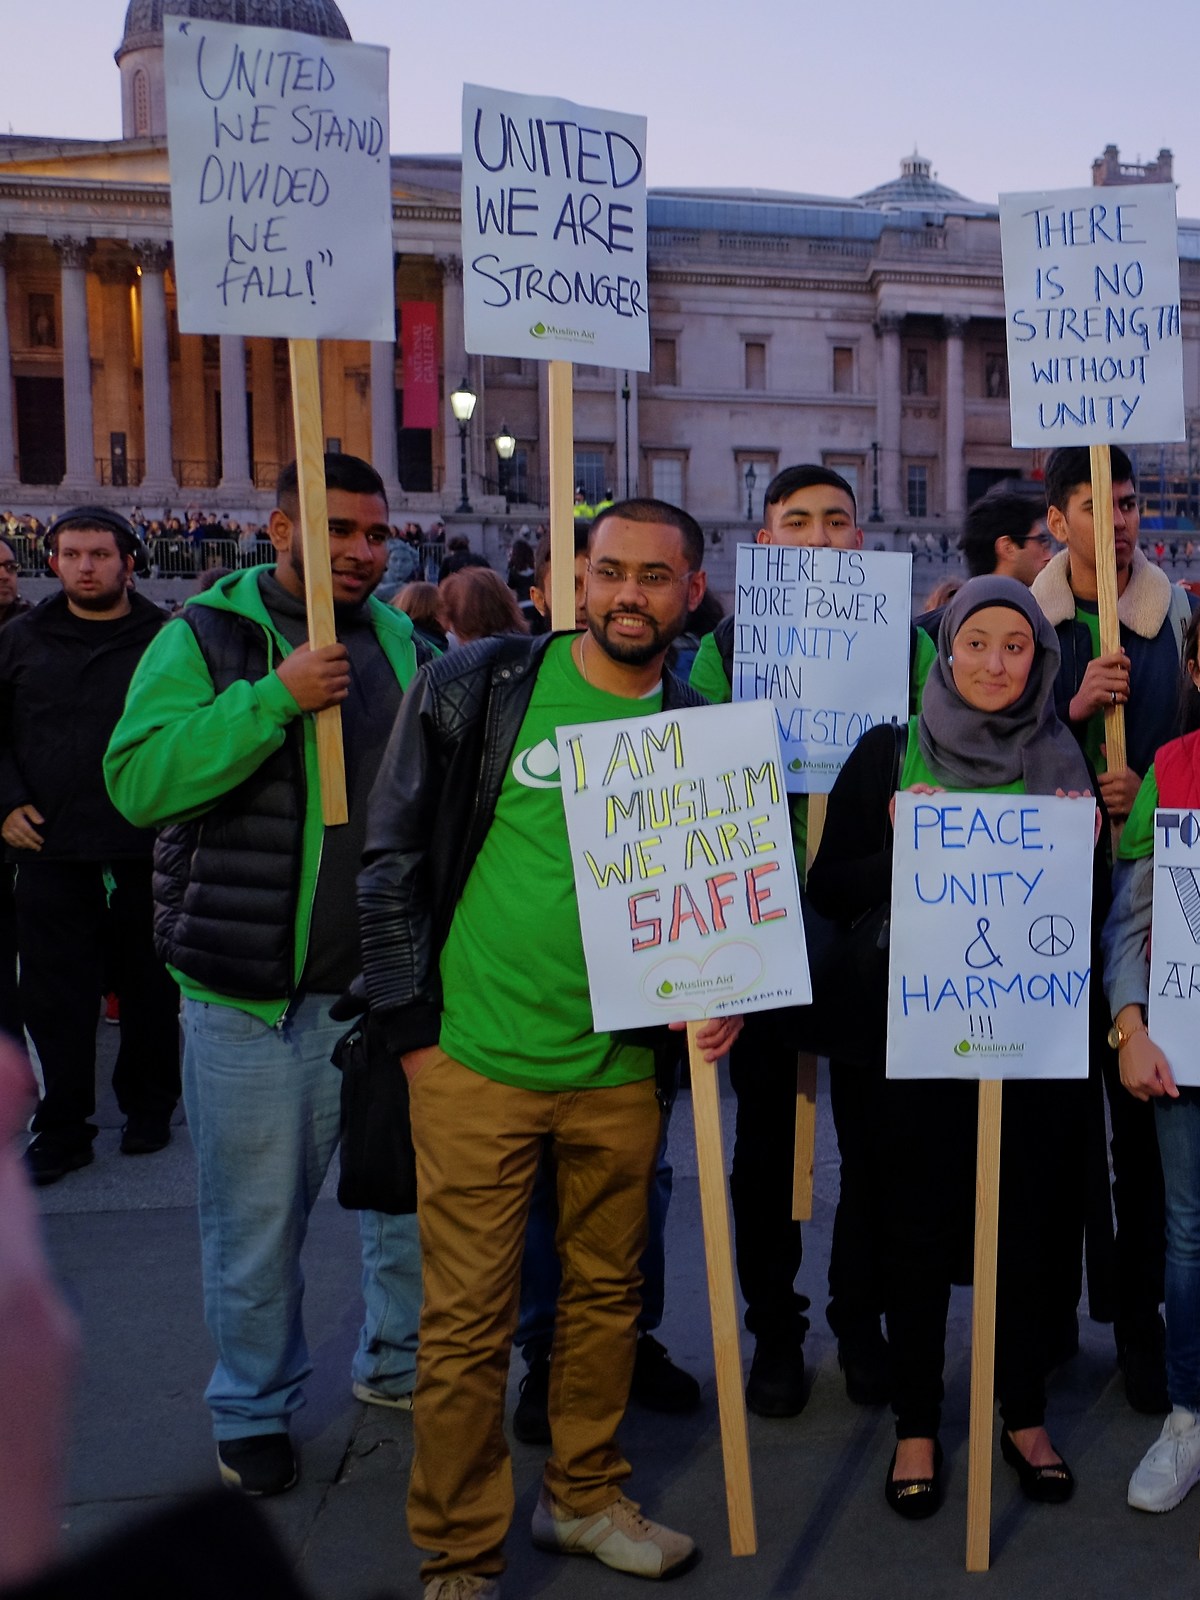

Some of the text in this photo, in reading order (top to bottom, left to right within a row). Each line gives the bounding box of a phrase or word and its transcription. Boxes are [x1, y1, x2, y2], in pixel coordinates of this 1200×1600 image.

[213, 106, 269, 149] WE
[473, 108, 643, 189] UNITED
[199, 154, 330, 207] DIVIDED
[227, 216, 288, 255] WE
[475, 186, 635, 254] WE ARE
[1021, 204, 1147, 248] THERE
[472, 254, 647, 318] STRONGER
[1035, 261, 1144, 301] IS NO
[1013, 305, 1181, 350] STRENGTH
[1031, 354, 1150, 384] WITHOUT
[1038, 394, 1140, 430] UNITY
[740, 546, 866, 586] THERE IS
[737, 584, 889, 625] MORE POWER
[735, 624, 858, 661] IN UNITY
[735, 660, 802, 700] THAN
[566, 721, 684, 795] I AM
[605, 761, 781, 838] MUSLIM
[914, 805, 1054, 851] PEACE,
[583, 814, 777, 890] WE ARE
[627, 861, 788, 952] SAFE
[915, 869, 1044, 906] UNITY
[965, 917, 1003, 969] &
[675, 975, 733, 991] Muslim Aid
[902, 967, 1090, 1017] HARMONY
[970, 1014, 994, 1040] !!!
